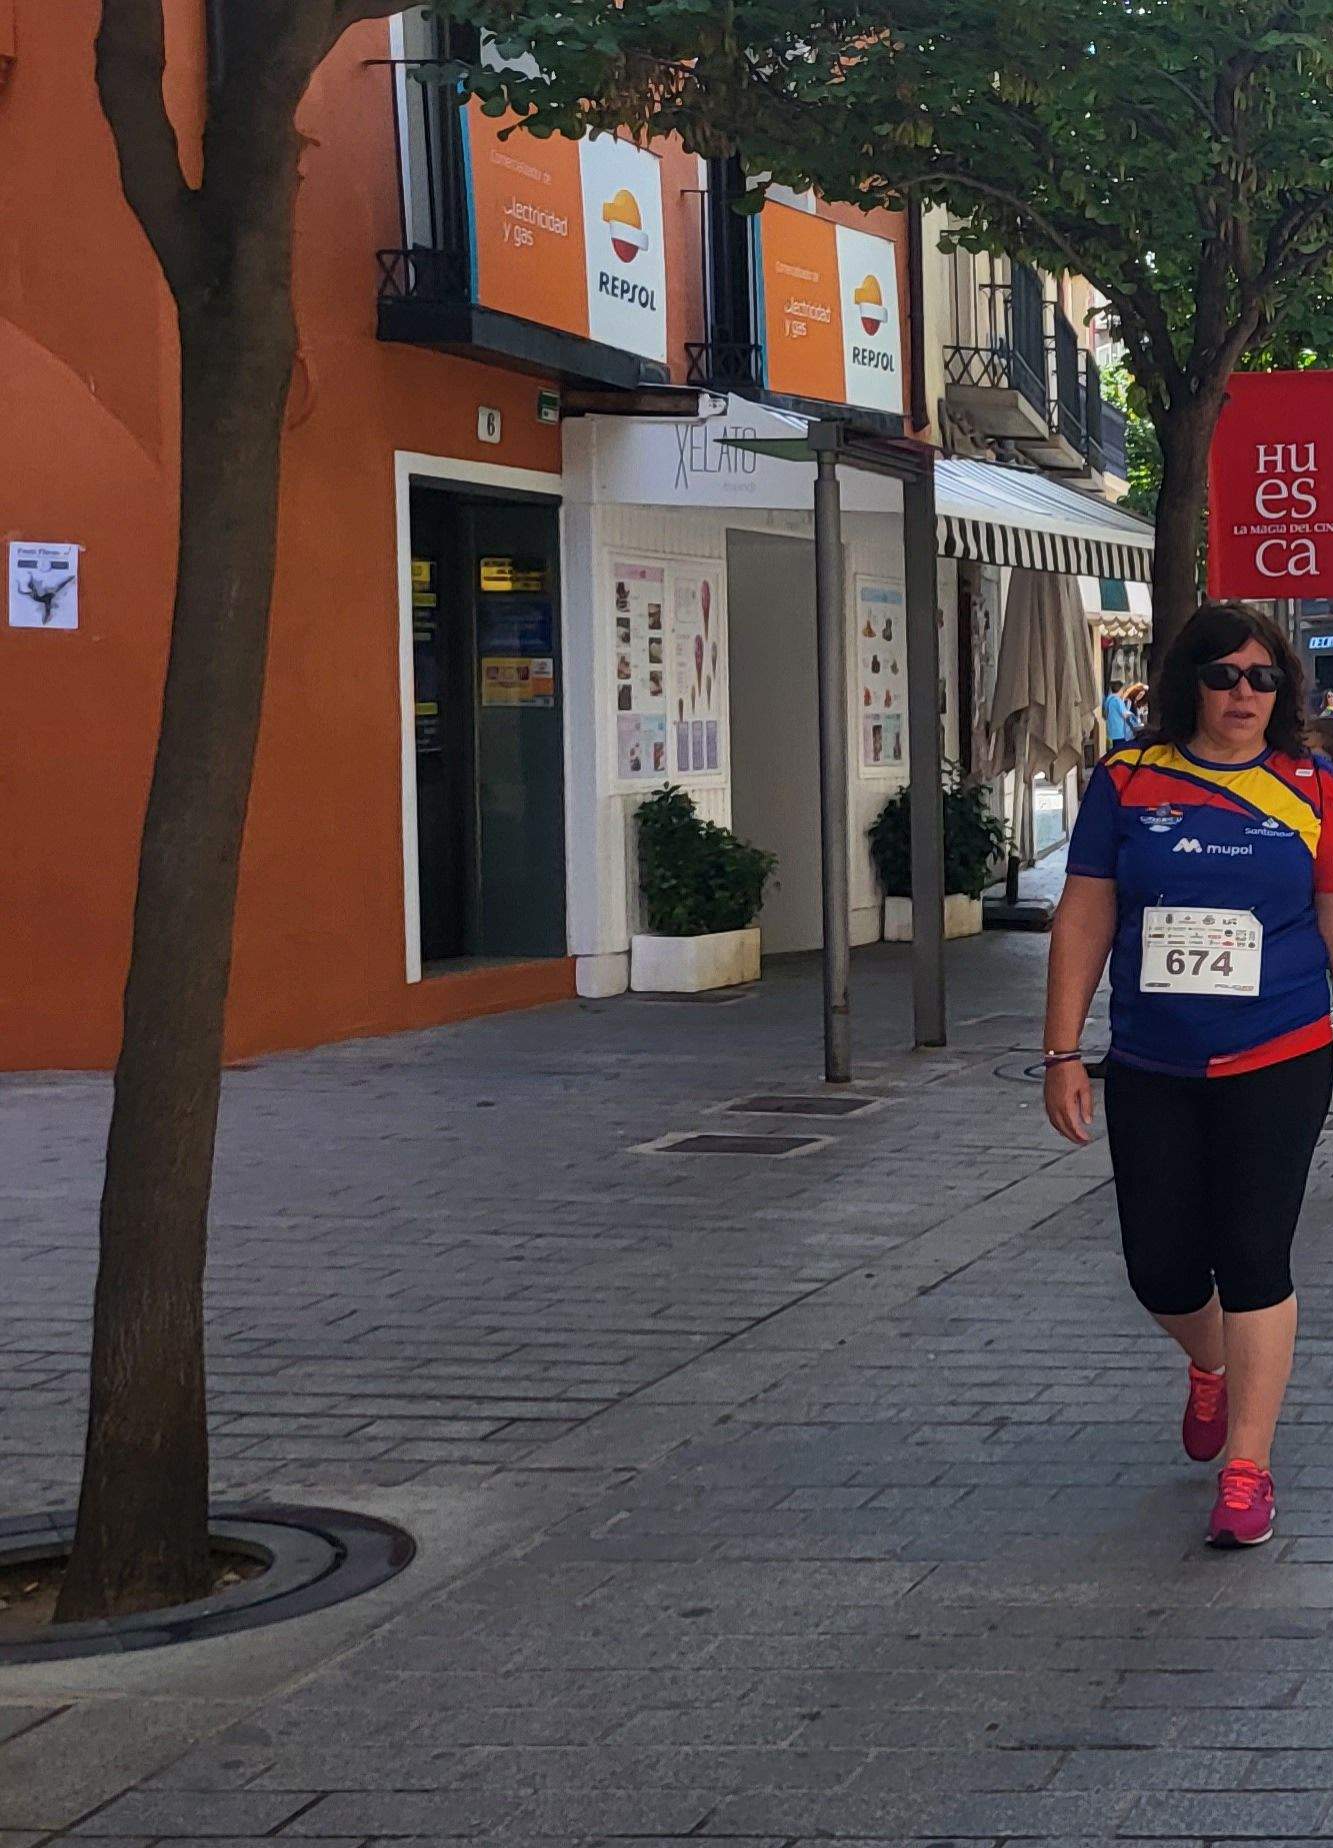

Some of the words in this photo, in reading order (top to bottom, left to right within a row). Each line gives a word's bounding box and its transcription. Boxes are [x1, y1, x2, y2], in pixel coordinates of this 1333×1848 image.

[504, 221, 511, 242] y
[514, 225, 534, 247] gas
[599, 271, 657, 312] REPSOL
[852, 346, 895, 372] REPSOL
[486, 412, 496, 437] 6
[675, 424, 758, 490] XELATO
[1255, 477, 1318, 519] es
[1255, 538, 1320, 578] ca
[1206, 844, 1253, 856] mupol
[1166, 949, 1233, 976] 674
